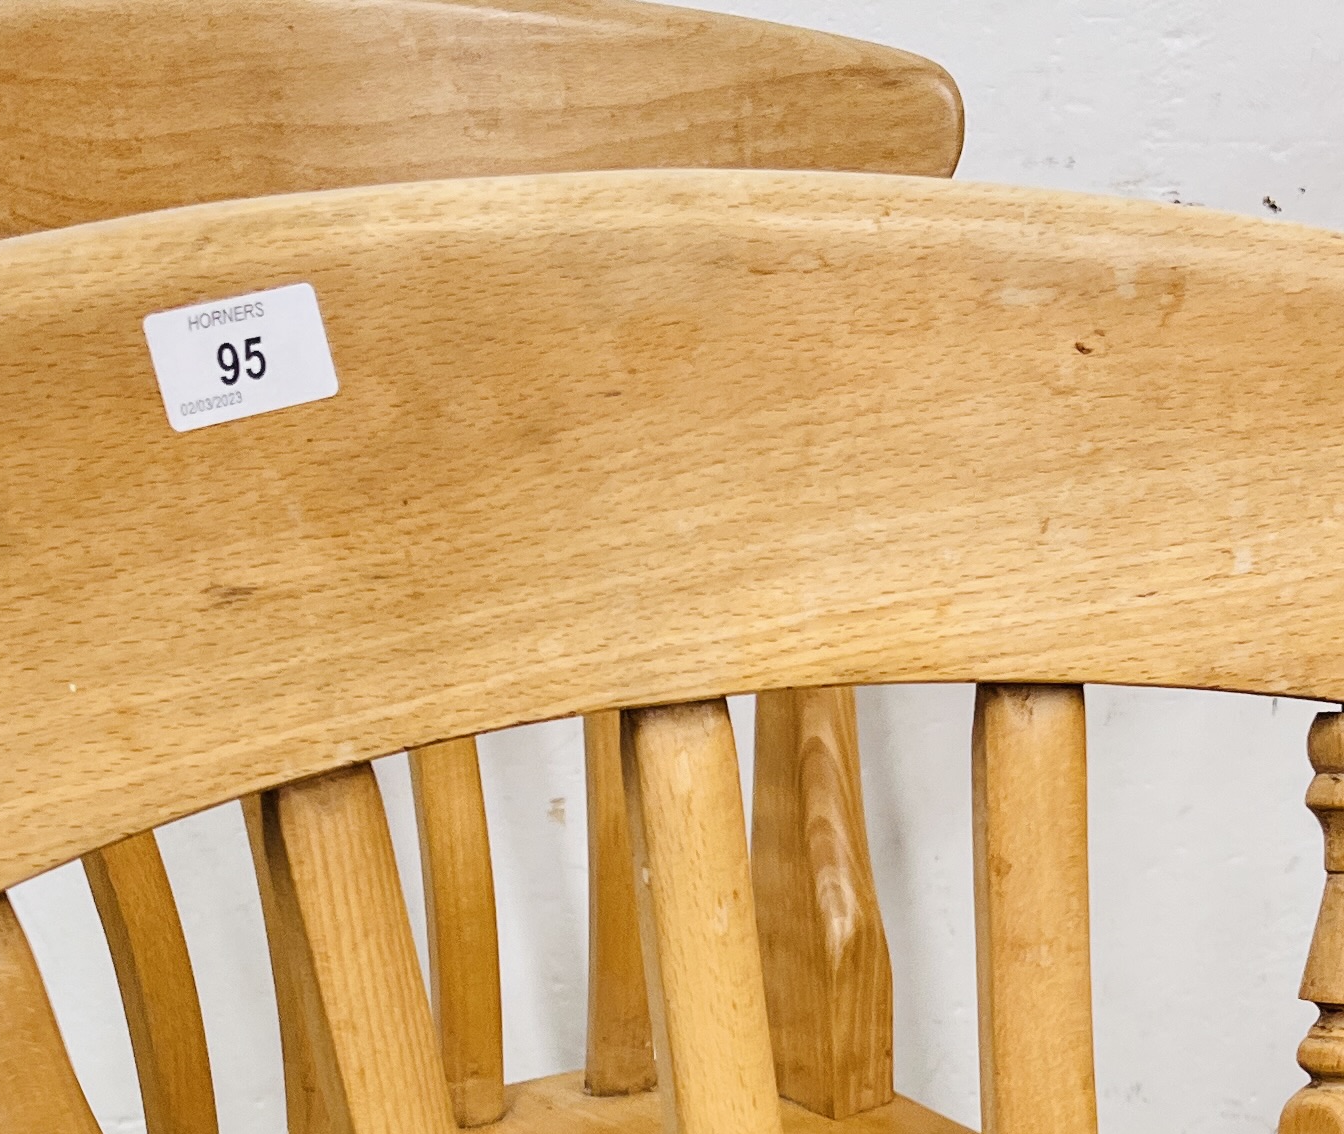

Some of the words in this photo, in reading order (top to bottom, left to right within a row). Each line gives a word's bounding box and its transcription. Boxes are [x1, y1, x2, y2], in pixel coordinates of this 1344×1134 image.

[188, 302, 264, 331] HORNERS
[217, 336, 266, 385] 95
[180, 391, 243, 416] 02/03/2023
